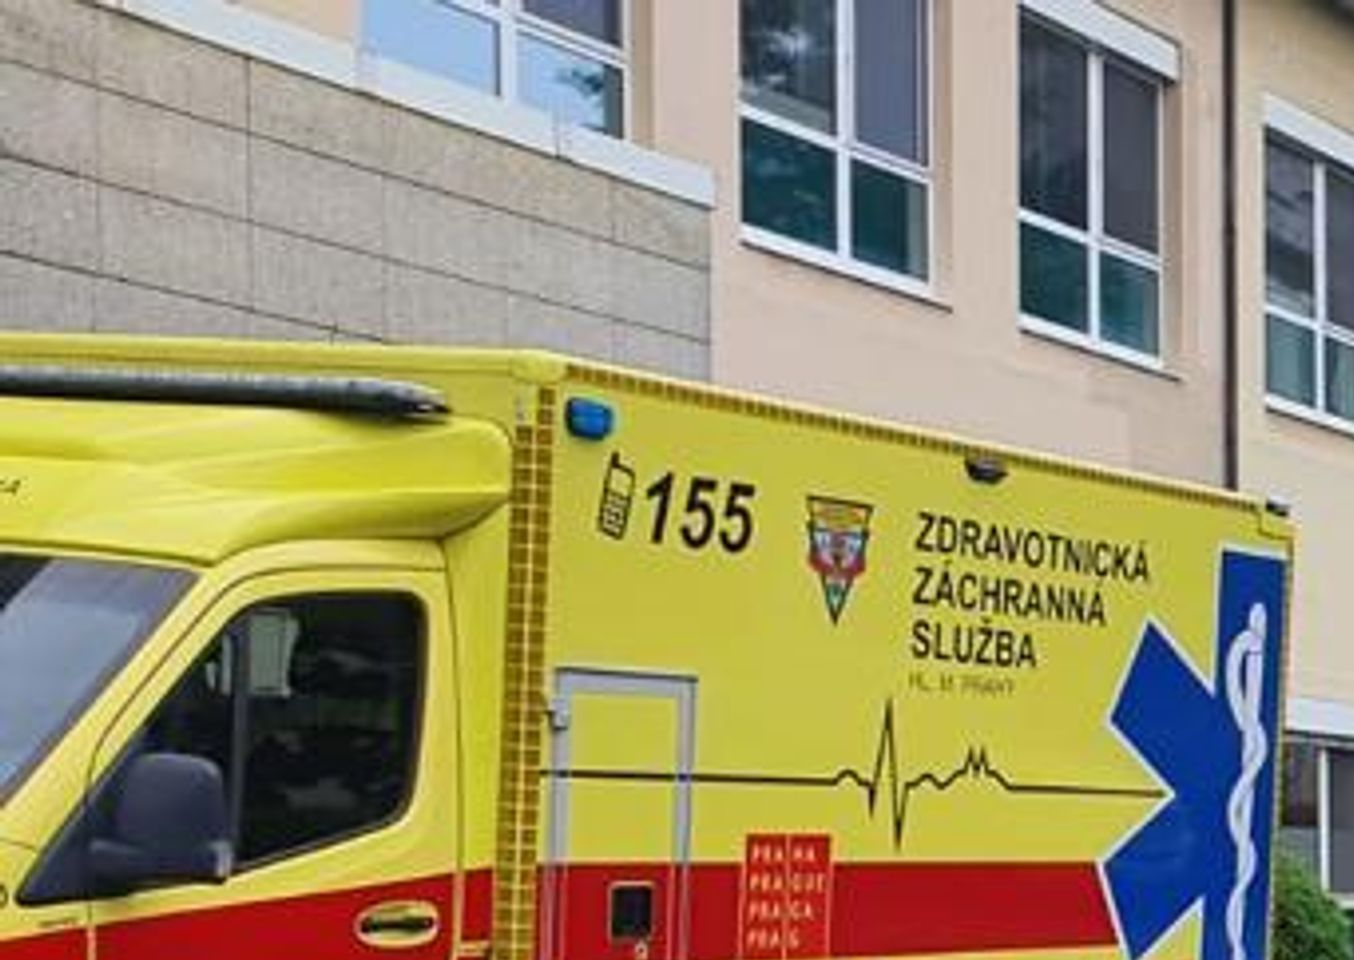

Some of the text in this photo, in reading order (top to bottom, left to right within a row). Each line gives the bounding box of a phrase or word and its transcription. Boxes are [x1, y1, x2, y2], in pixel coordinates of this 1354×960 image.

[645, 471, 757, 553] 155
[915, 511, 1149, 581] ZDRAVOTNICKÁ
[911, 557, 1107, 627] ZÁCHRANNÁ
[911, 617, 1036, 668] SLUŽBA
